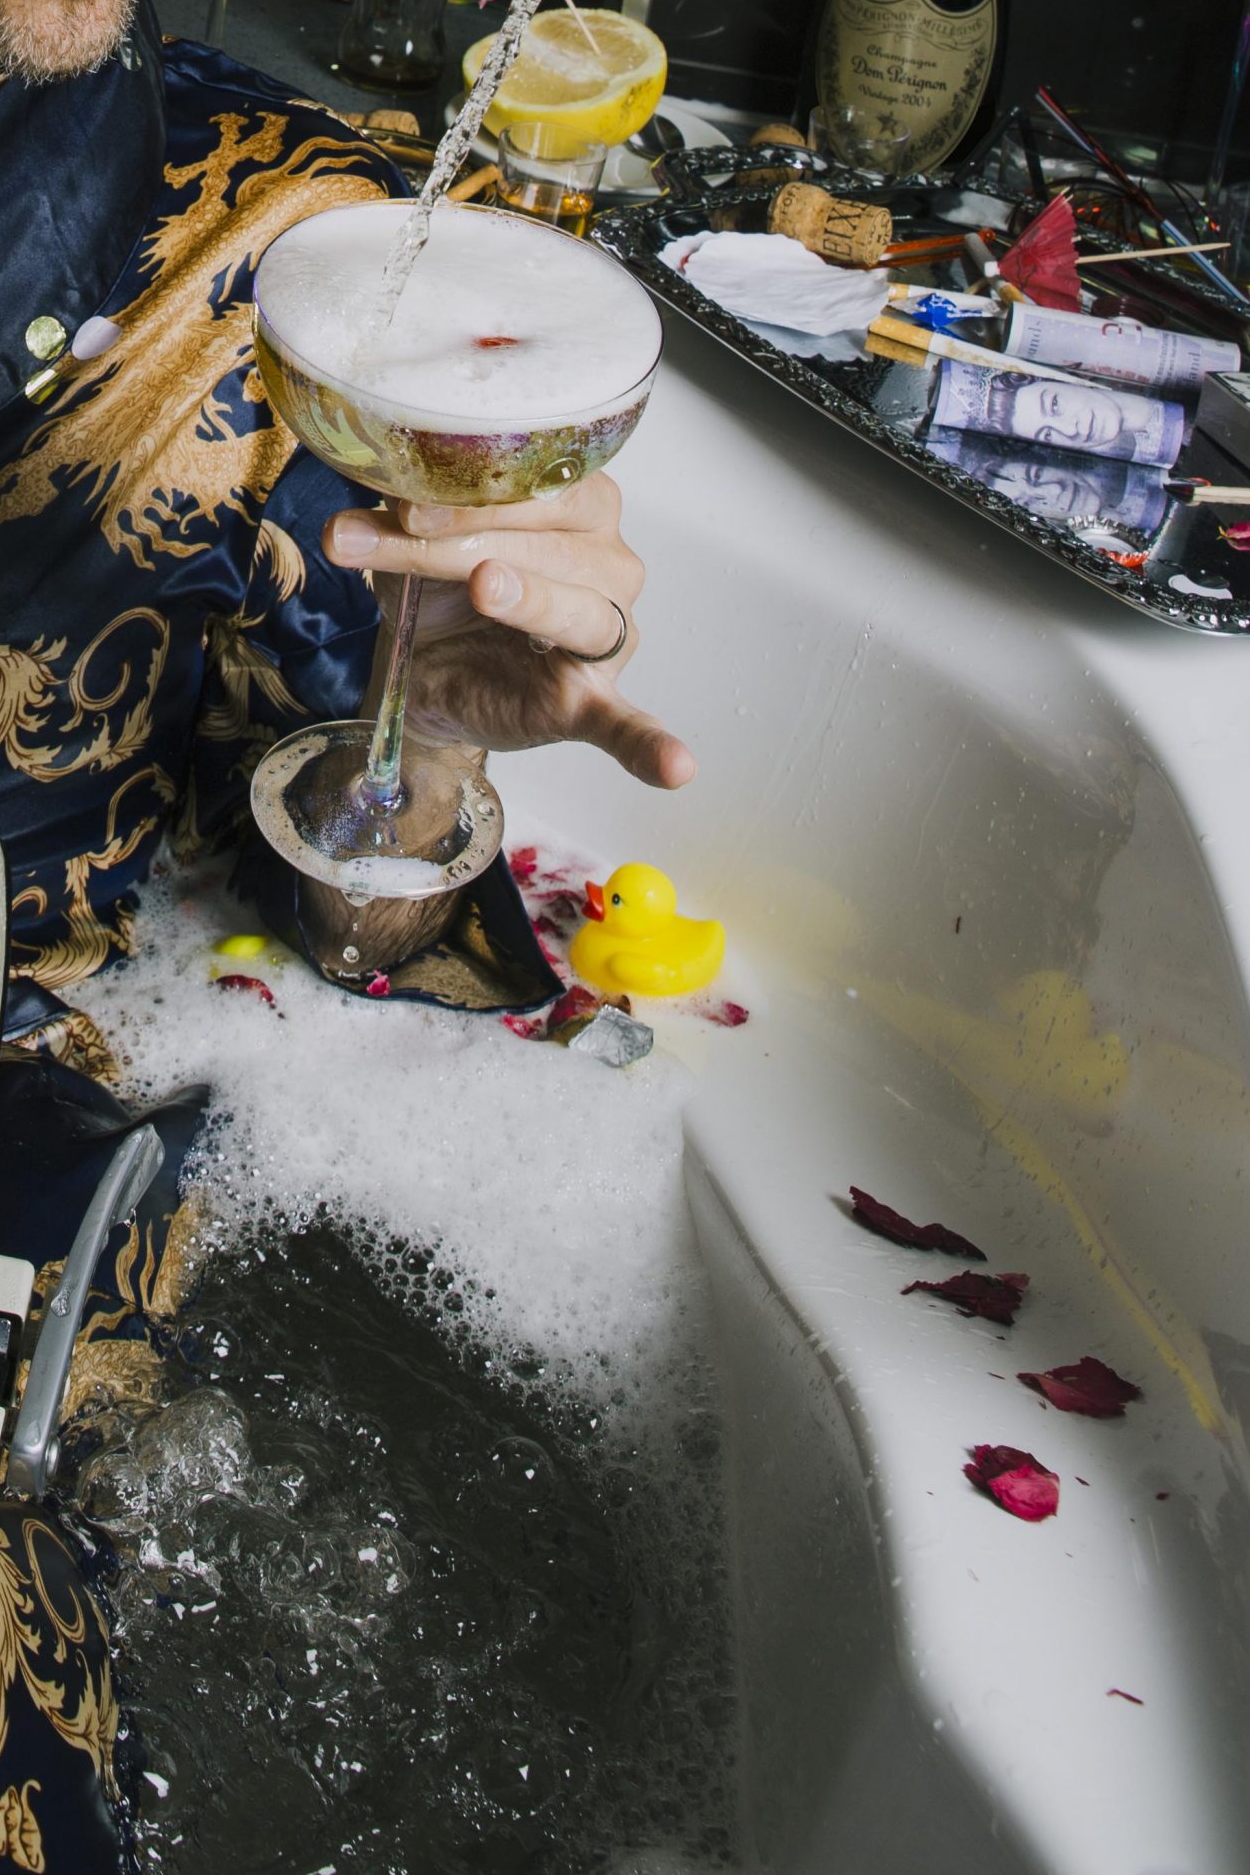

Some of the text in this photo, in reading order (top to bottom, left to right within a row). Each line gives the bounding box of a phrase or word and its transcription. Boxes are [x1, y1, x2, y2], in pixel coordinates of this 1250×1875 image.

[867, 44, 937, 69] Champagne
[851, 55, 948, 97] Dom Pérignon
[858, 84, 900, 104] Vintage
